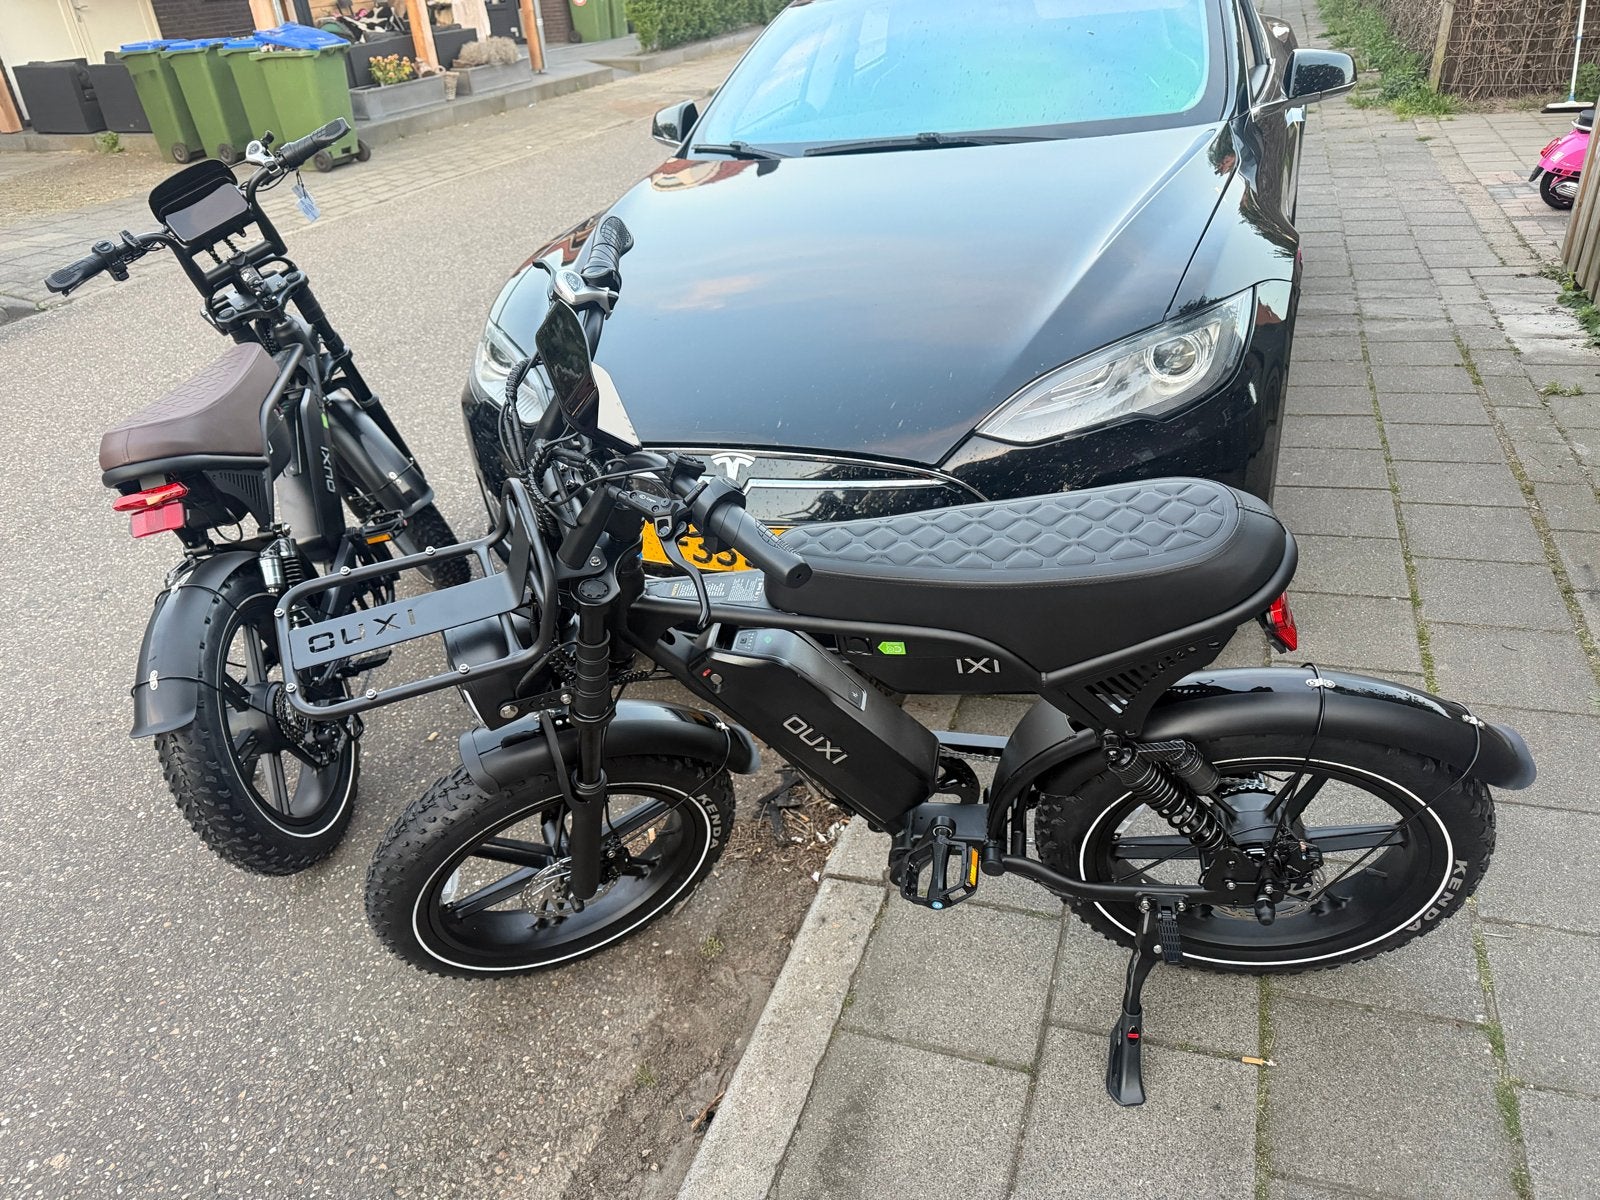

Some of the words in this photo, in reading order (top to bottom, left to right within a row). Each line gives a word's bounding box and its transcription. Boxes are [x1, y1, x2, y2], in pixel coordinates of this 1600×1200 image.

[320, 446, 336, 492] OUXI
[308, 609, 416, 653] OUXI
[956, 657, 1000, 674] IXI
[783, 716, 848, 764] OUXI
[696, 793, 722, 849] KENDA
[1405, 859, 1468, 932] KENDA
